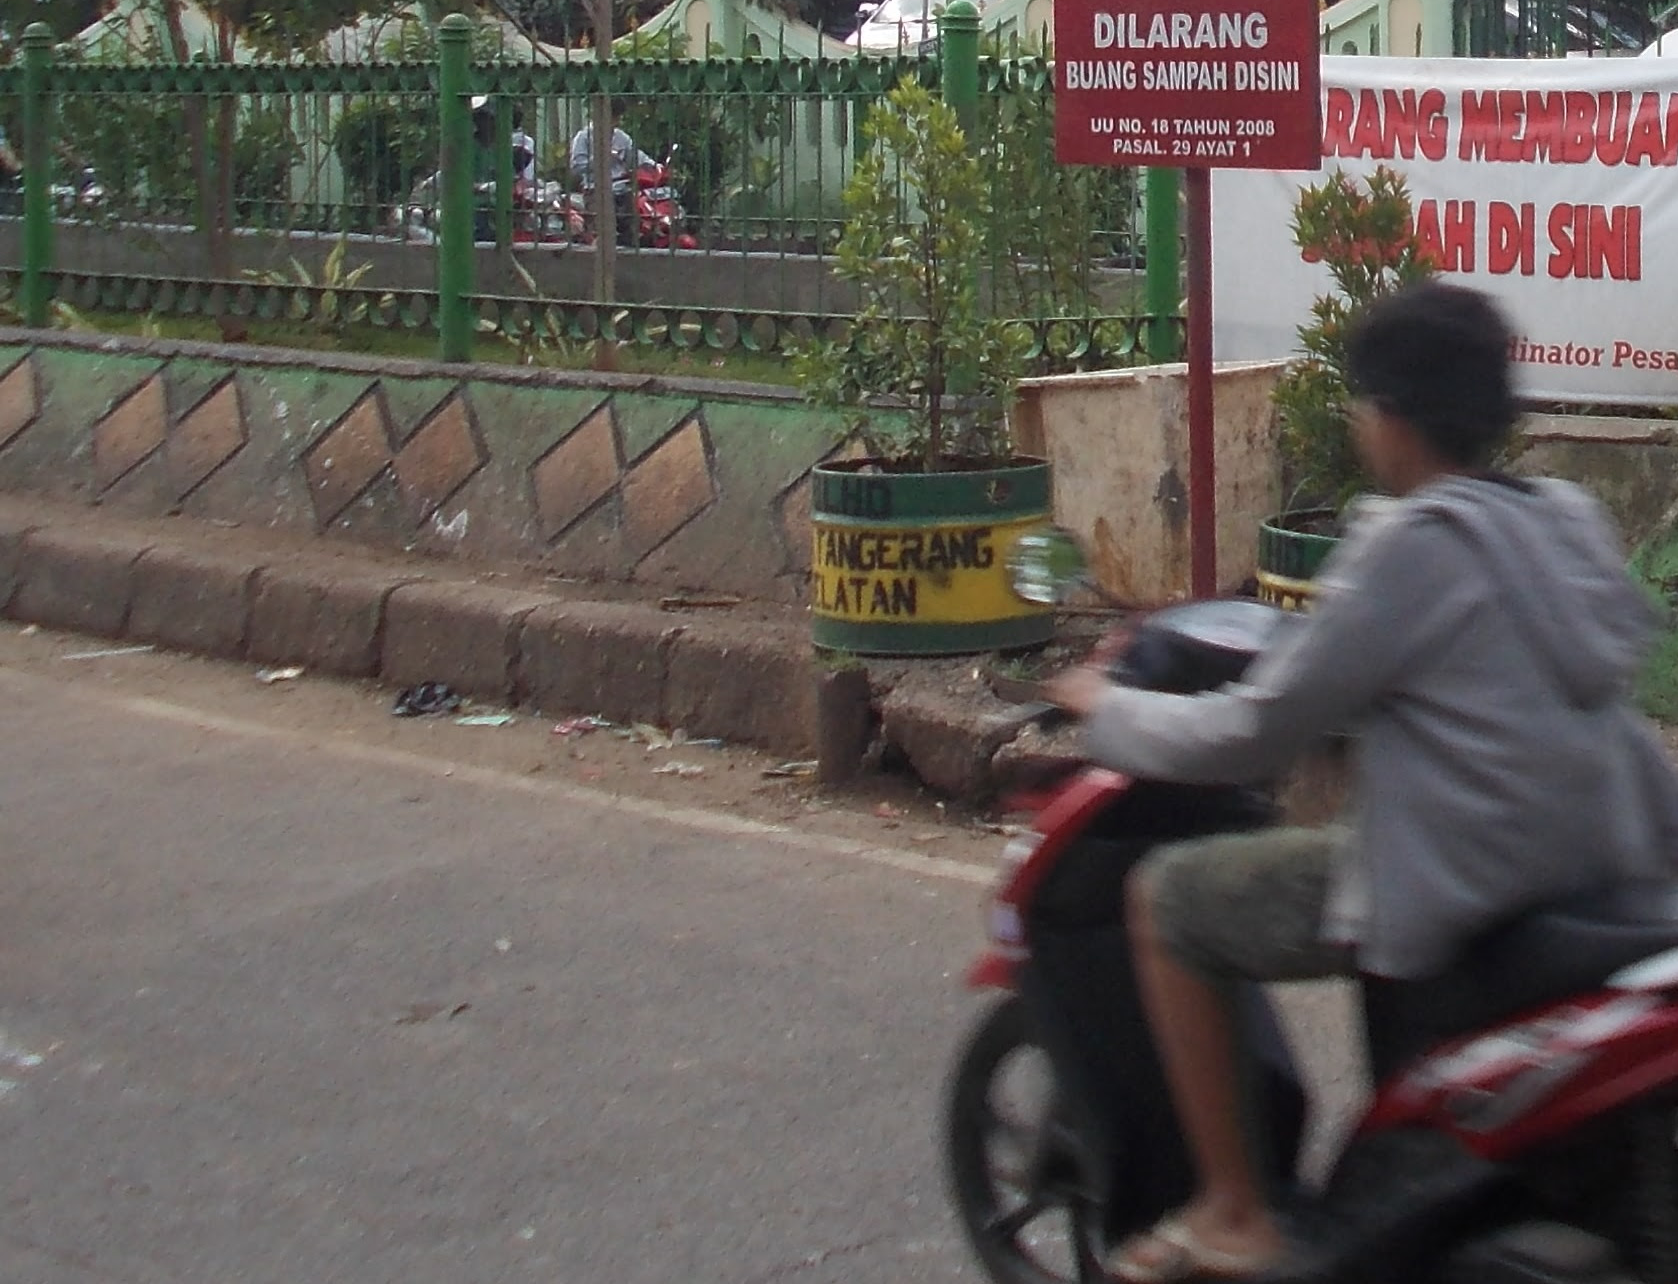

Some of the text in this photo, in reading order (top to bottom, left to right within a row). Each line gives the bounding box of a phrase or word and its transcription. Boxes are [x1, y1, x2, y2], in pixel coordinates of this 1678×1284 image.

[1094, 12, 1268, 49] DILARANG
[1066, 61, 1299, 92] BUANG SAMPAH DISINI
[1091, 119, 1275, 136] UU NO. 18 TAHUN 2008
[1113, 139, 1250, 156] PASAL. 29 AYAT 1
[1488, 201, 1535, 276] DI
[1547, 203, 1641, 281] SINI
[814, 524, 994, 571] TANGERANG
